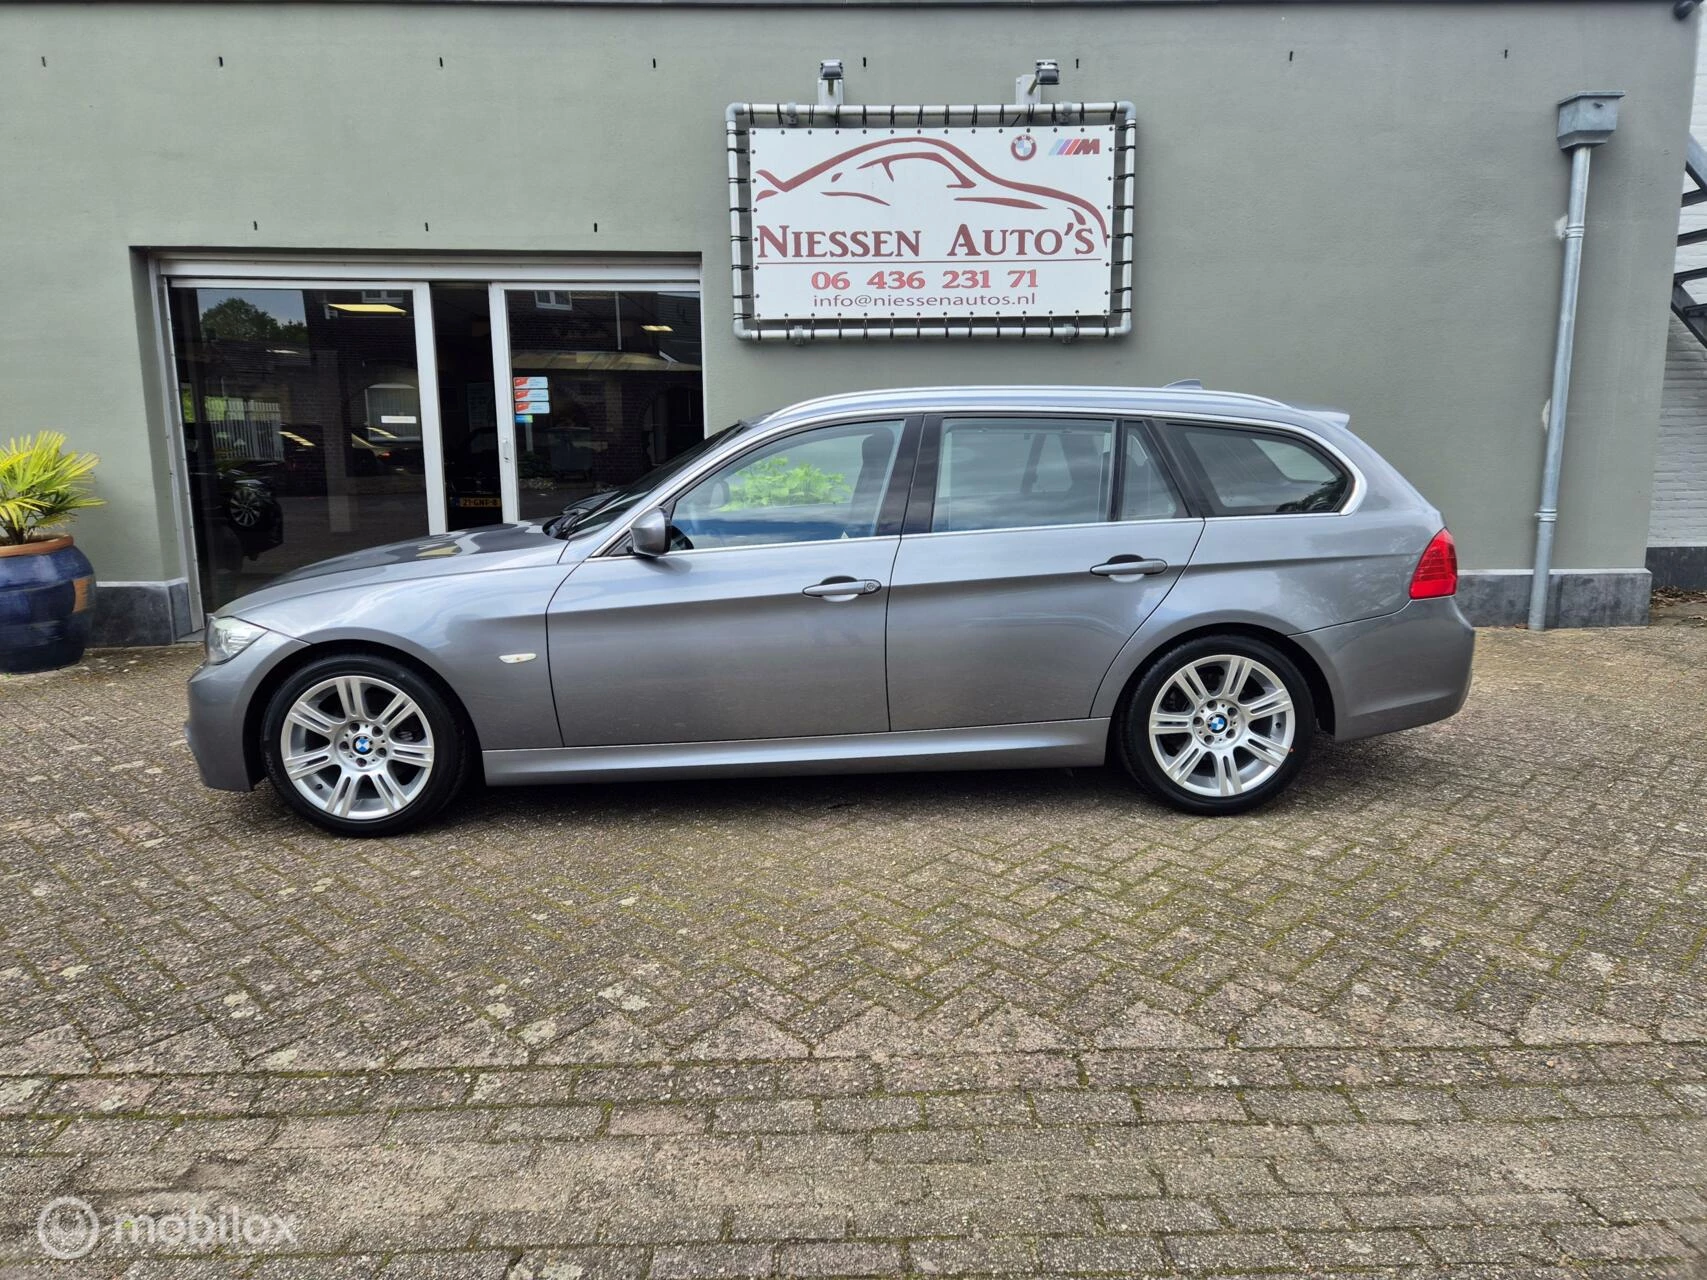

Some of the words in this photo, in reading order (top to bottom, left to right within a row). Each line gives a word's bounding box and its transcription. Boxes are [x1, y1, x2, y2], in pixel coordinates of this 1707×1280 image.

[811, 271, 851, 290] 06
[866, 270, 926, 290] 436
[942, 270, 992, 289] 231
[1007, 269, 1039, 288] 71
[813, 293, 1036, 307] info@niessenautos.nl
